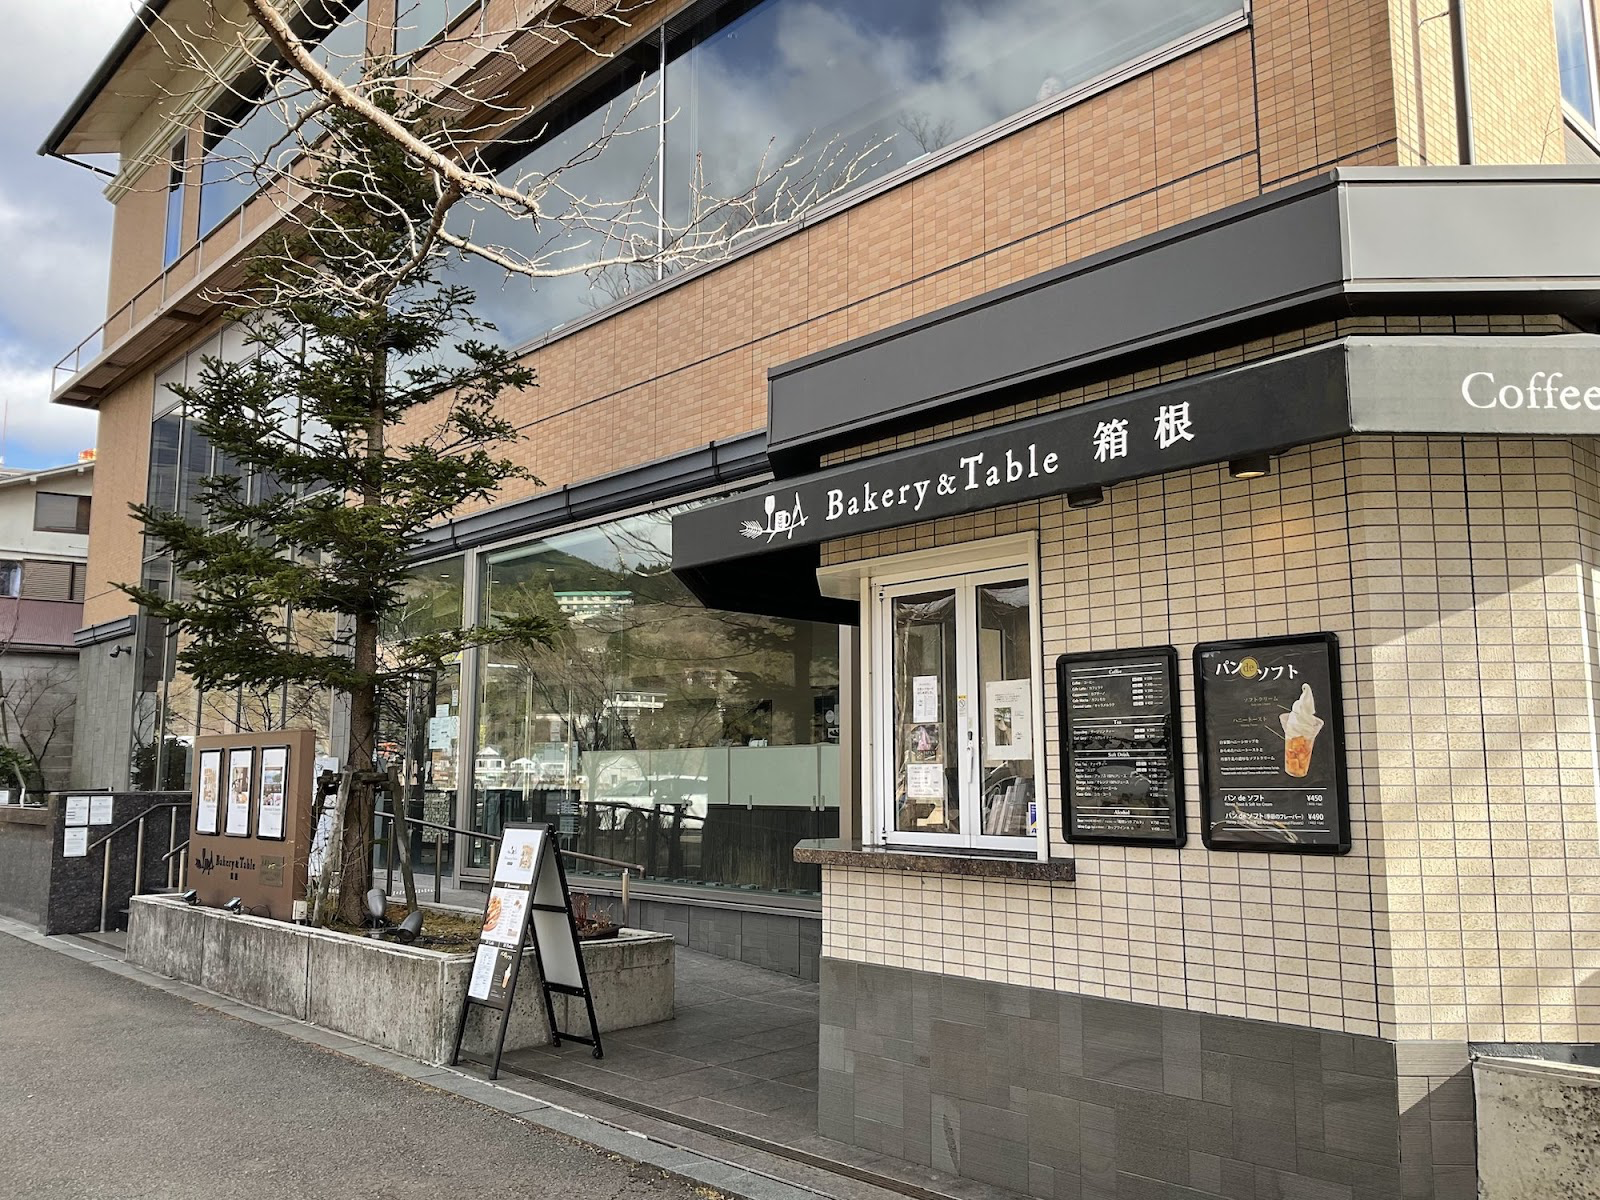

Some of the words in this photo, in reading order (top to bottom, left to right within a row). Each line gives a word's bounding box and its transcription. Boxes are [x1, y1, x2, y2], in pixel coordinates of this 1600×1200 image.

[1461, 371, 1600, 411] Coffee
[825, 479, 931, 521] Bakery
[936, 473, 957, 496] &
[959, 443, 1059, 491] Table
[1092, 401, 1195, 463] 箱根
[1215, 659, 1243, 676] パン
[1243, 662, 1255, 673] de
[1257, 664, 1299, 682] ソフト
[216, 854, 234, 870] Bakery
[240, 856, 256, 870] Table
